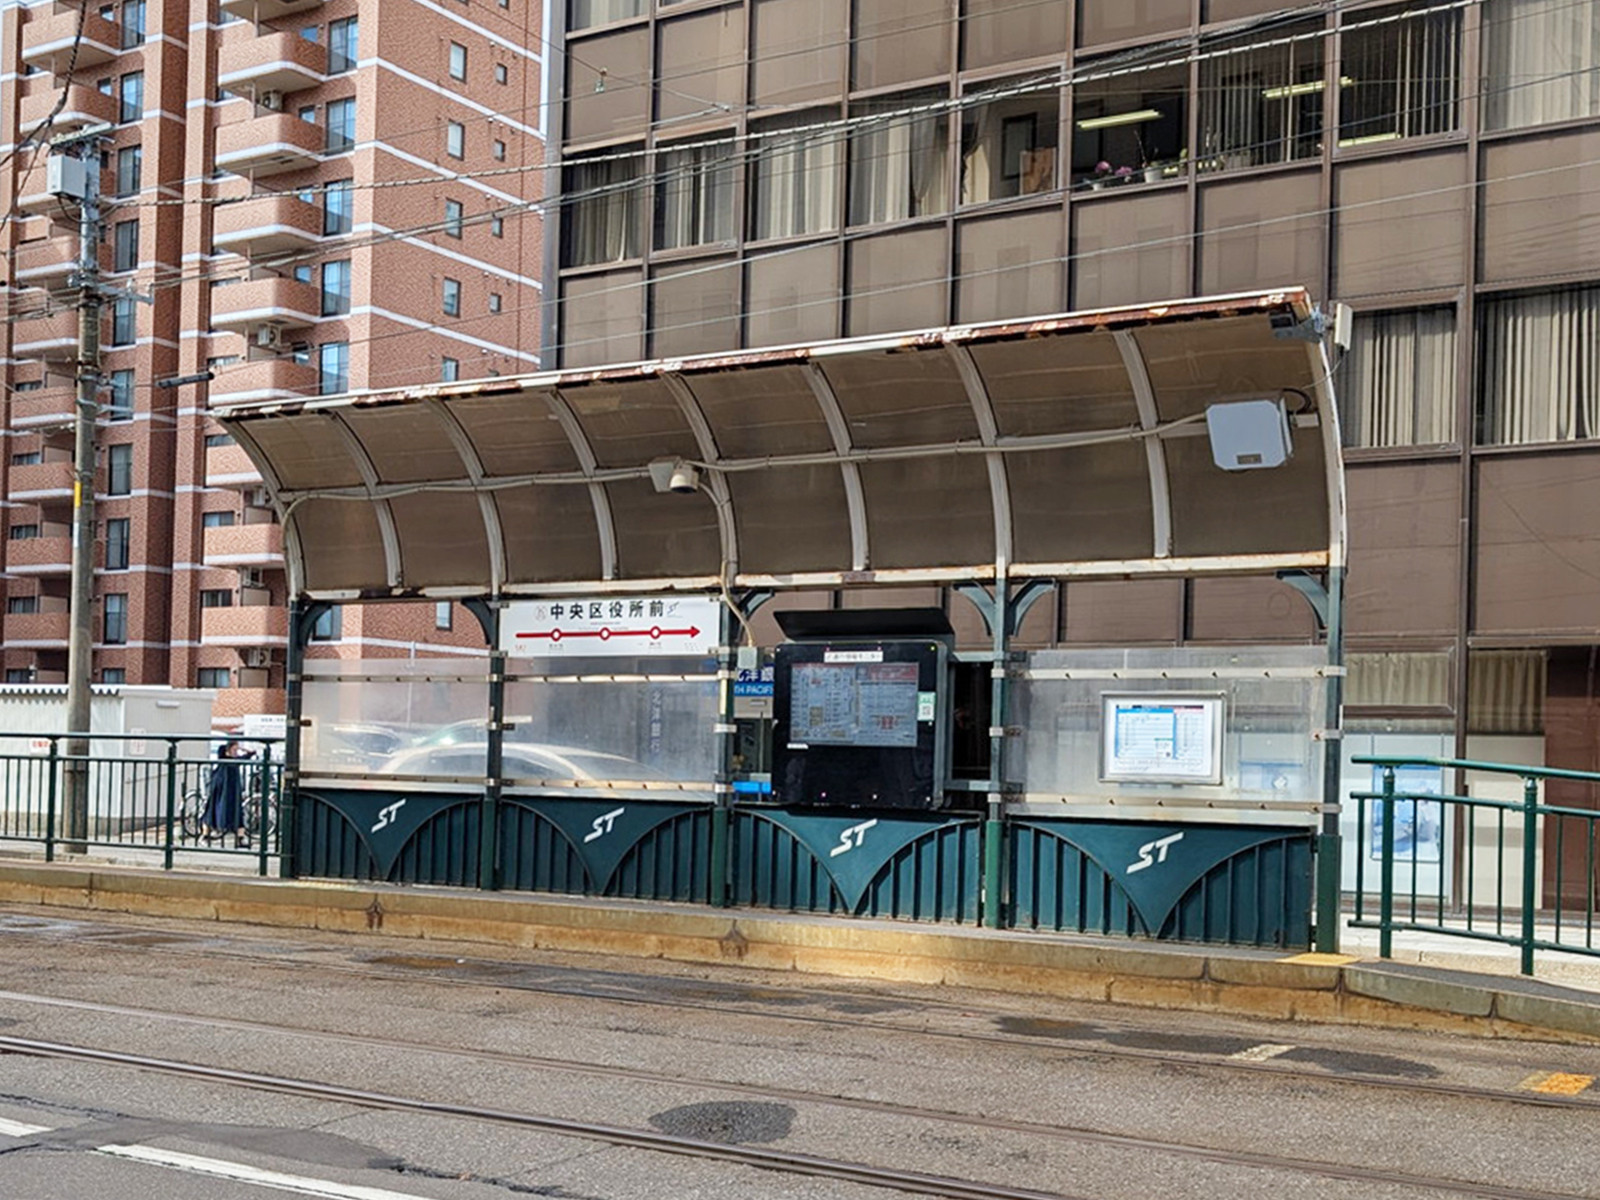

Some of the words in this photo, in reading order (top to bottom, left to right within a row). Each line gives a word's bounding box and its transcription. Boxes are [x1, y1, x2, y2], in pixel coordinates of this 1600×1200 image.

[550, 600, 664, 620] 中央区役所前
[371, 798, 406, 833] ST
[583, 806, 625, 843] ST
[830, 818, 878, 857] ST
[1126, 831, 1184, 874] ST
